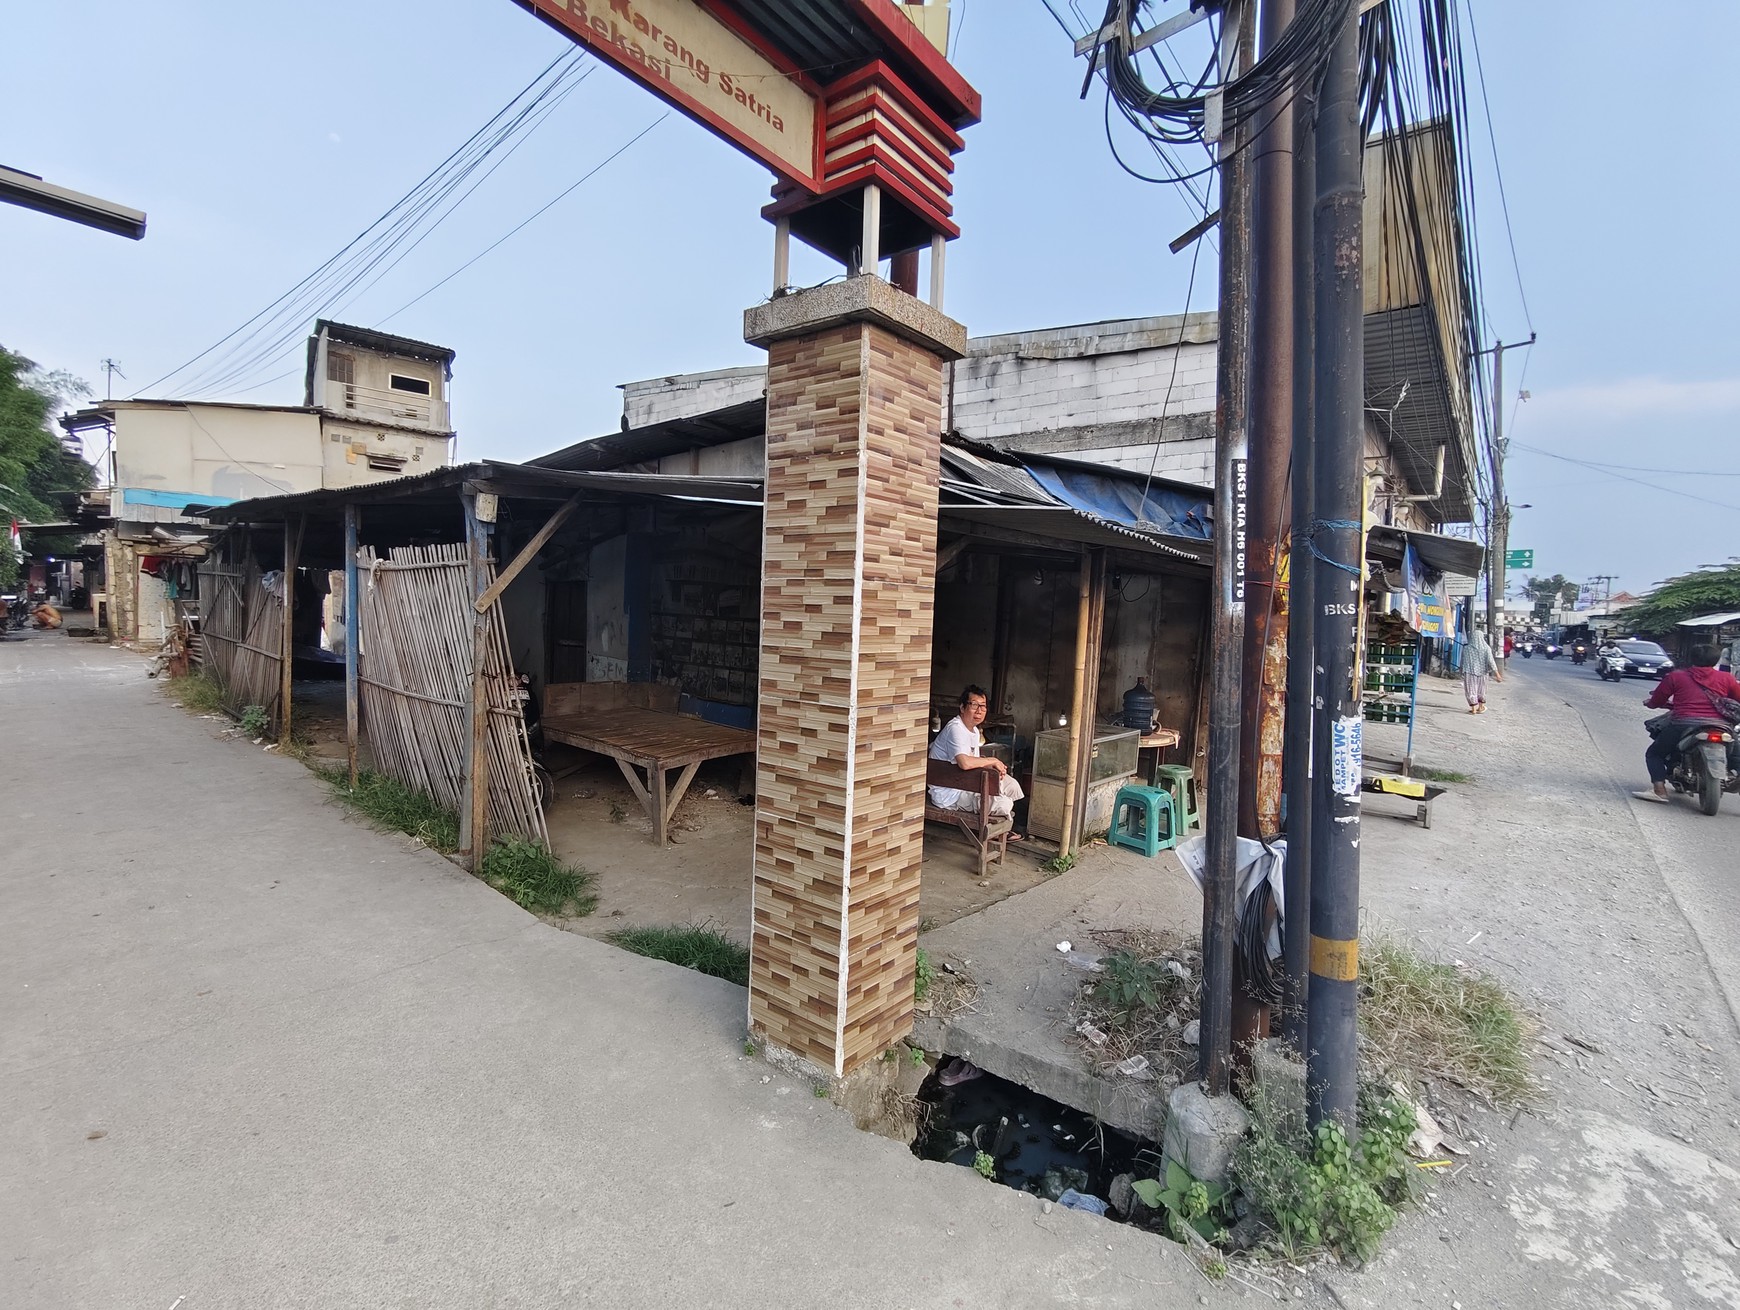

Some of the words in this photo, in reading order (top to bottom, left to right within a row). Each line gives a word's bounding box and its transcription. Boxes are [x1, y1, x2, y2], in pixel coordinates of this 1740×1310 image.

[566, 0, 672, 82] Bekasi
[609, 0, 711, 84] Karang
[718, 71, 785, 134] Satria
[1237, 463, 1247, 498] BKS1
[1237, 503, 1246, 528] KIA
[1236, 552, 1246, 577] 001
[1334, 723, 1346, 748] WC
